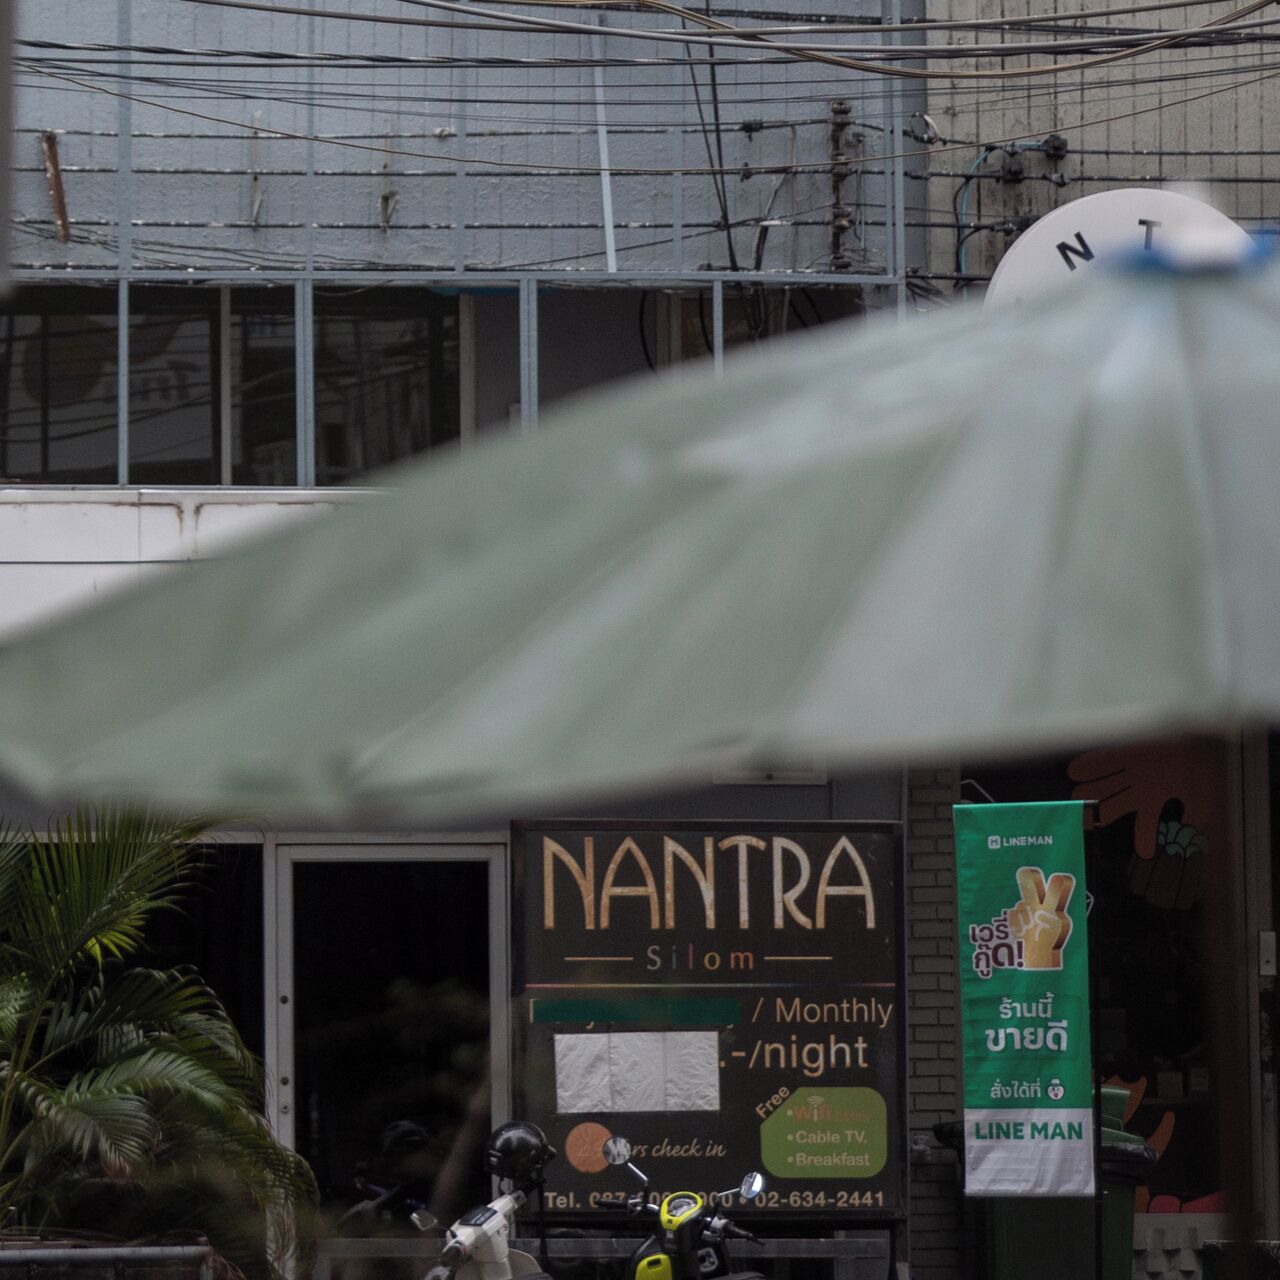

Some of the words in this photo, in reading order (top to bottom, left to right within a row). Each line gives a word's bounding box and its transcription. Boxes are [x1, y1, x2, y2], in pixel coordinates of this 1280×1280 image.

[543, 835, 876, 930] NANTRA
[646, 944, 755, 971] Silom
[775, 997, 894, 1029] Monthly
[998, 992, 1055, 1019] ร้านนี้
[985, 1020, 1069, 1052] ขายดี
[755, 1085, 791, 1119] Free
[795, 1130, 841, 1144] Cable
[974, 1122, 1025, 1141] LINE
[1030, 1121, 1084, 1140] MAN
[651, 1137, 702, 1158] check
[705, 1138, 727, 1158] in
[795, 1152, 871, 1167] Breakfast
[544, 1192, 581, 1209] Tel.
[754, 1191, 884, 1208] 02-634-2441
